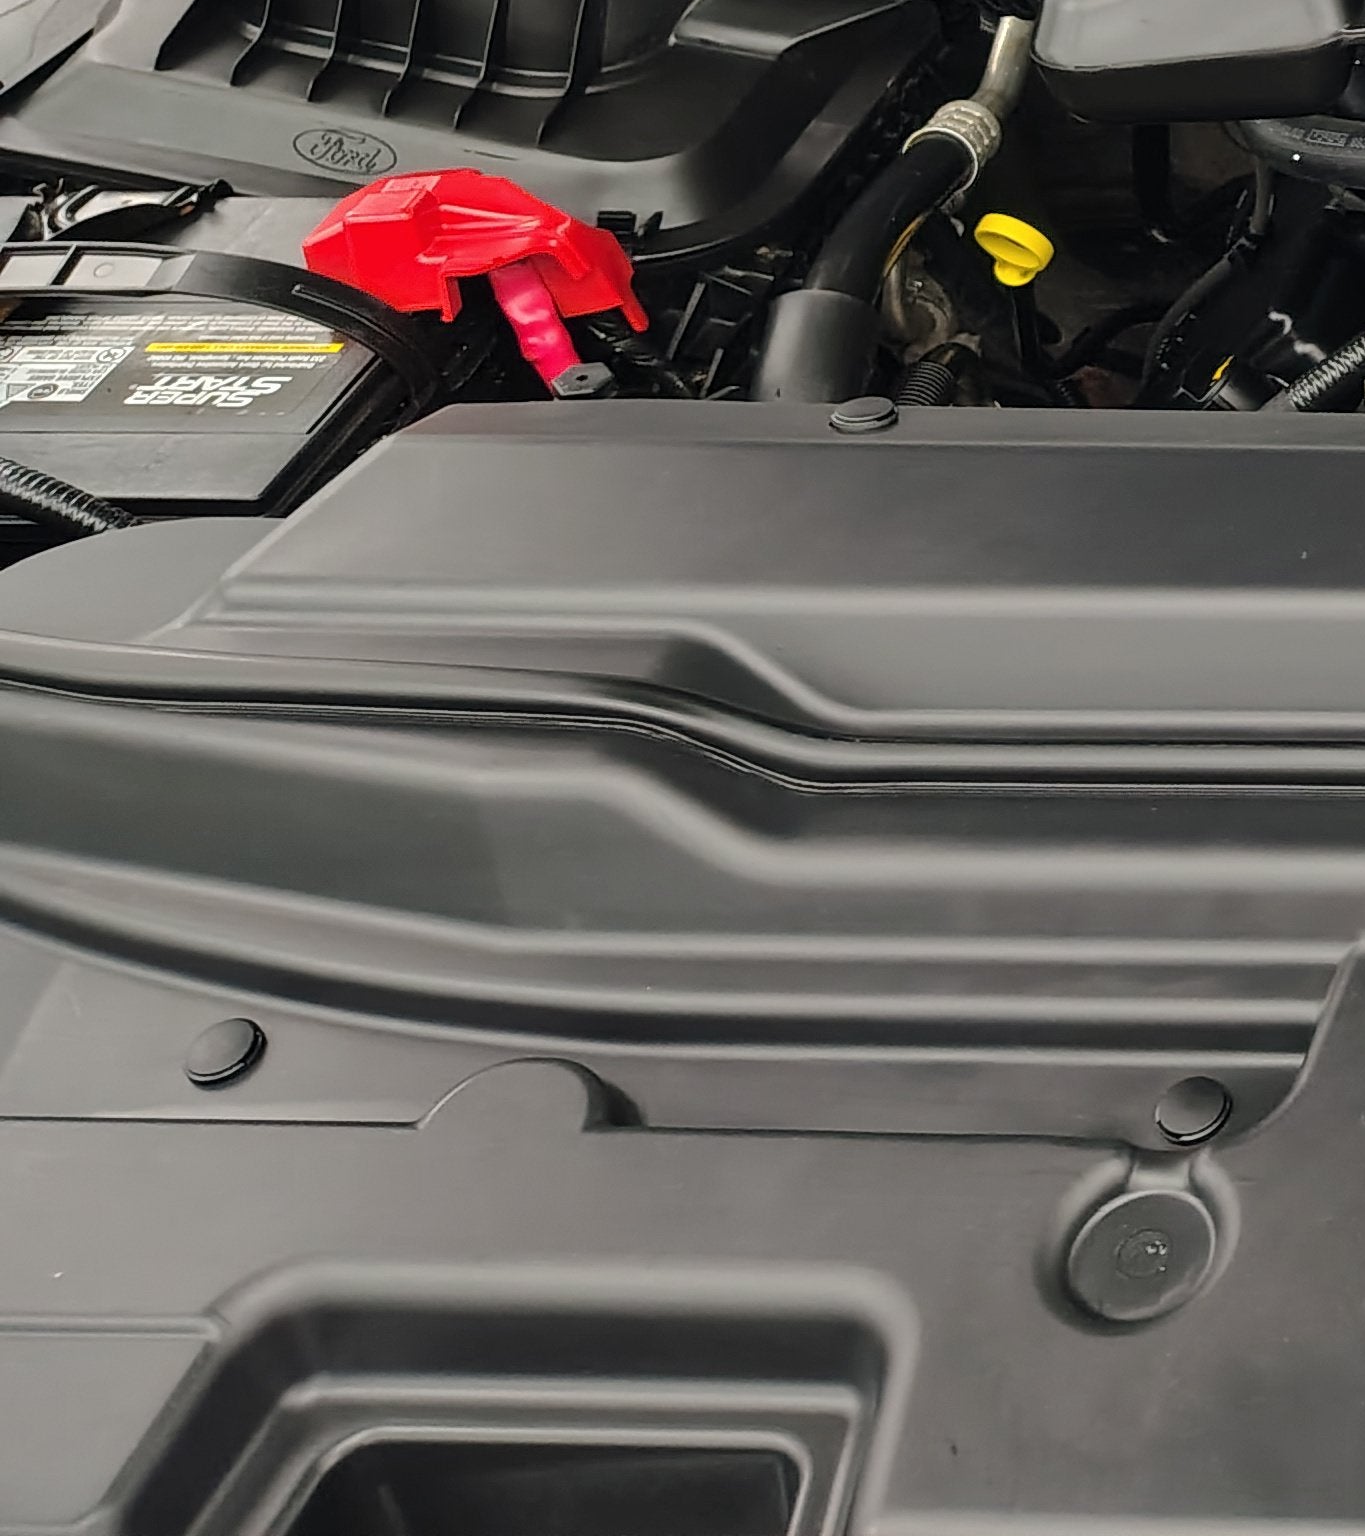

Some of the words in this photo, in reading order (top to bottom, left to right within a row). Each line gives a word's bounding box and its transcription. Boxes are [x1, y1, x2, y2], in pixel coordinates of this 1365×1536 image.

[308, 131, 382, 174] Ford
[134, 375, 293, 397] START
[123, 390, 255, 408] SUPER
